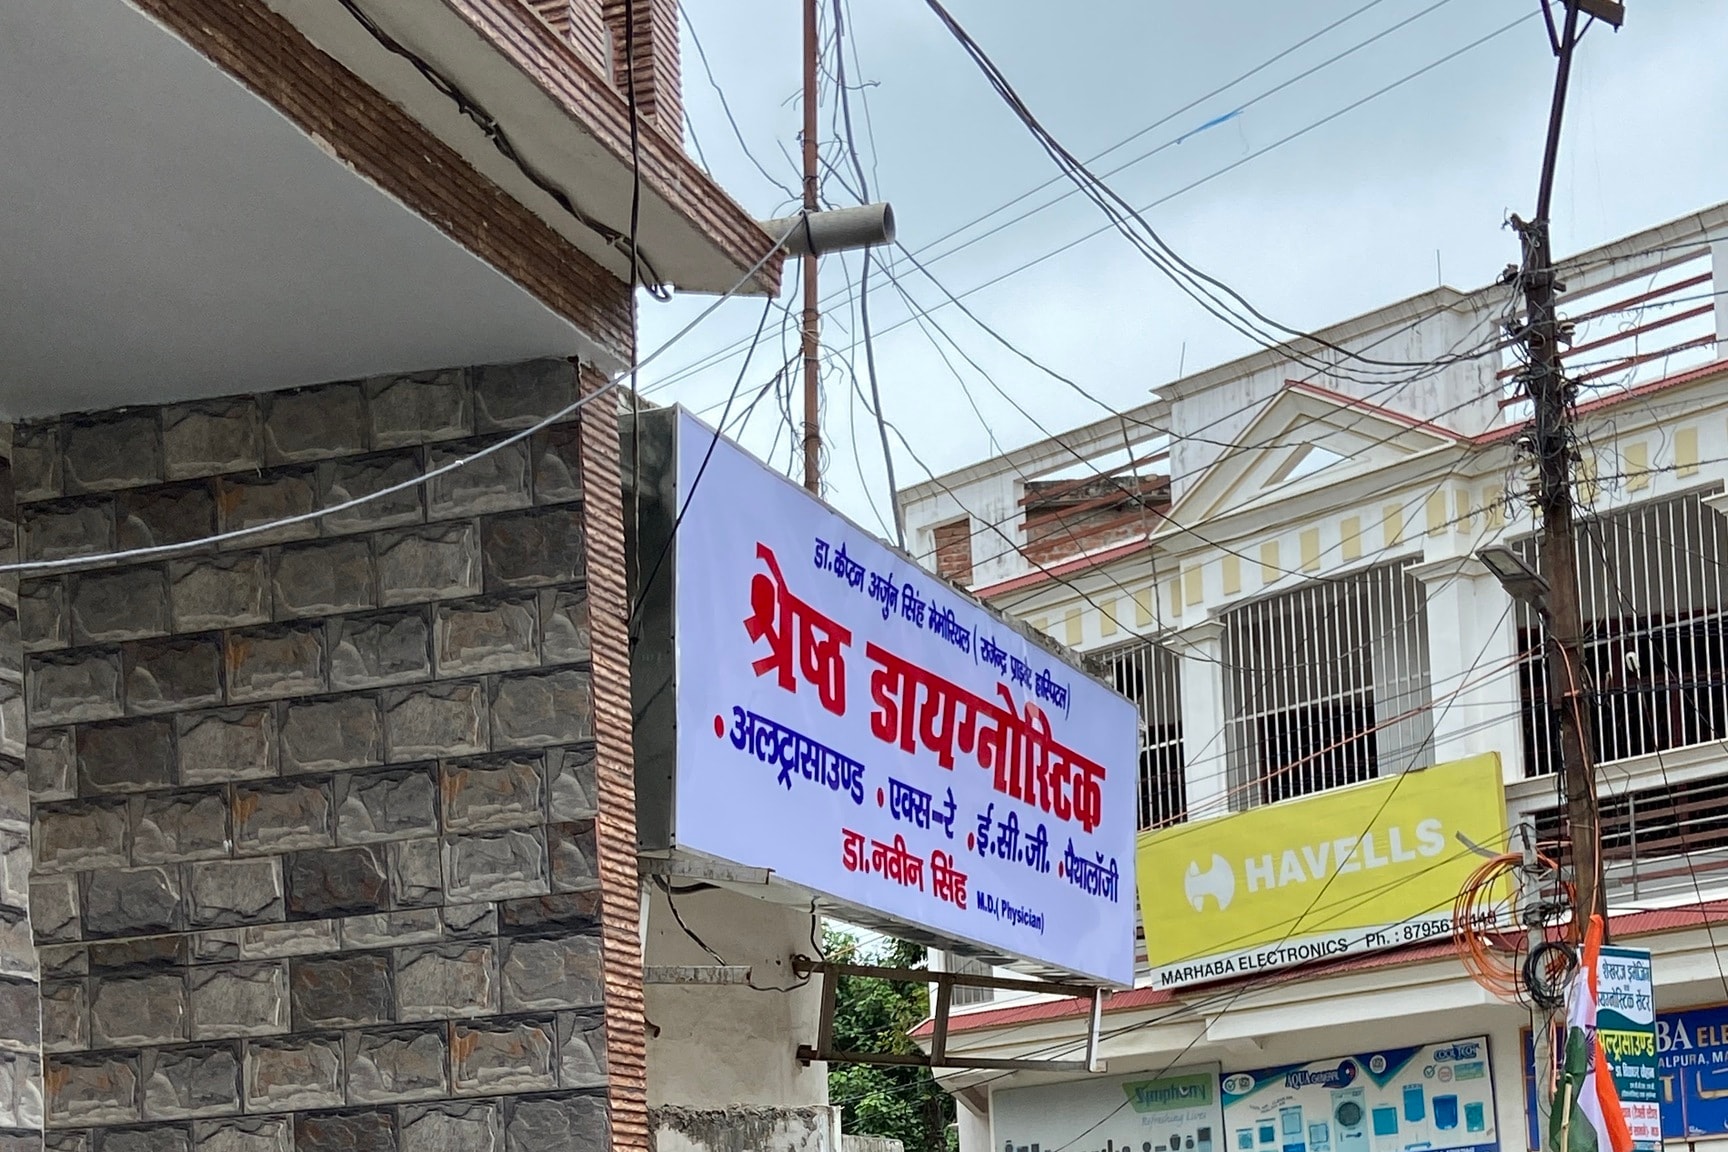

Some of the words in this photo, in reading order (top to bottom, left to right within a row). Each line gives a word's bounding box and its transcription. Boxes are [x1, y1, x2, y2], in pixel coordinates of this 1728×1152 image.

[868, 572, 899, 621] अर्जुन
[901, 583, 926, 629] सिंह
[743, 541, 852, 717] श्रेष्ठ
[866, 641, 1106, 834] डायग्नोस्टिक
[888, 777, 957, 839] एक्स-रे
[976, 802, 1050, 874] ई.सी.जी.
[1064, 837, 1119, 903] पैथालॉजी
[1245, 818, 1446, 893] HAVELLS
[930, 850, 968, 910] सिंह
[1161, 960, 1235, 986] MARHABA
[1238, 937, 1348, 975] ELECTRONICS
[1135, 1083, 1206, 1106] Symphony
[1285, 1070, 1310, 1090] AQUA
